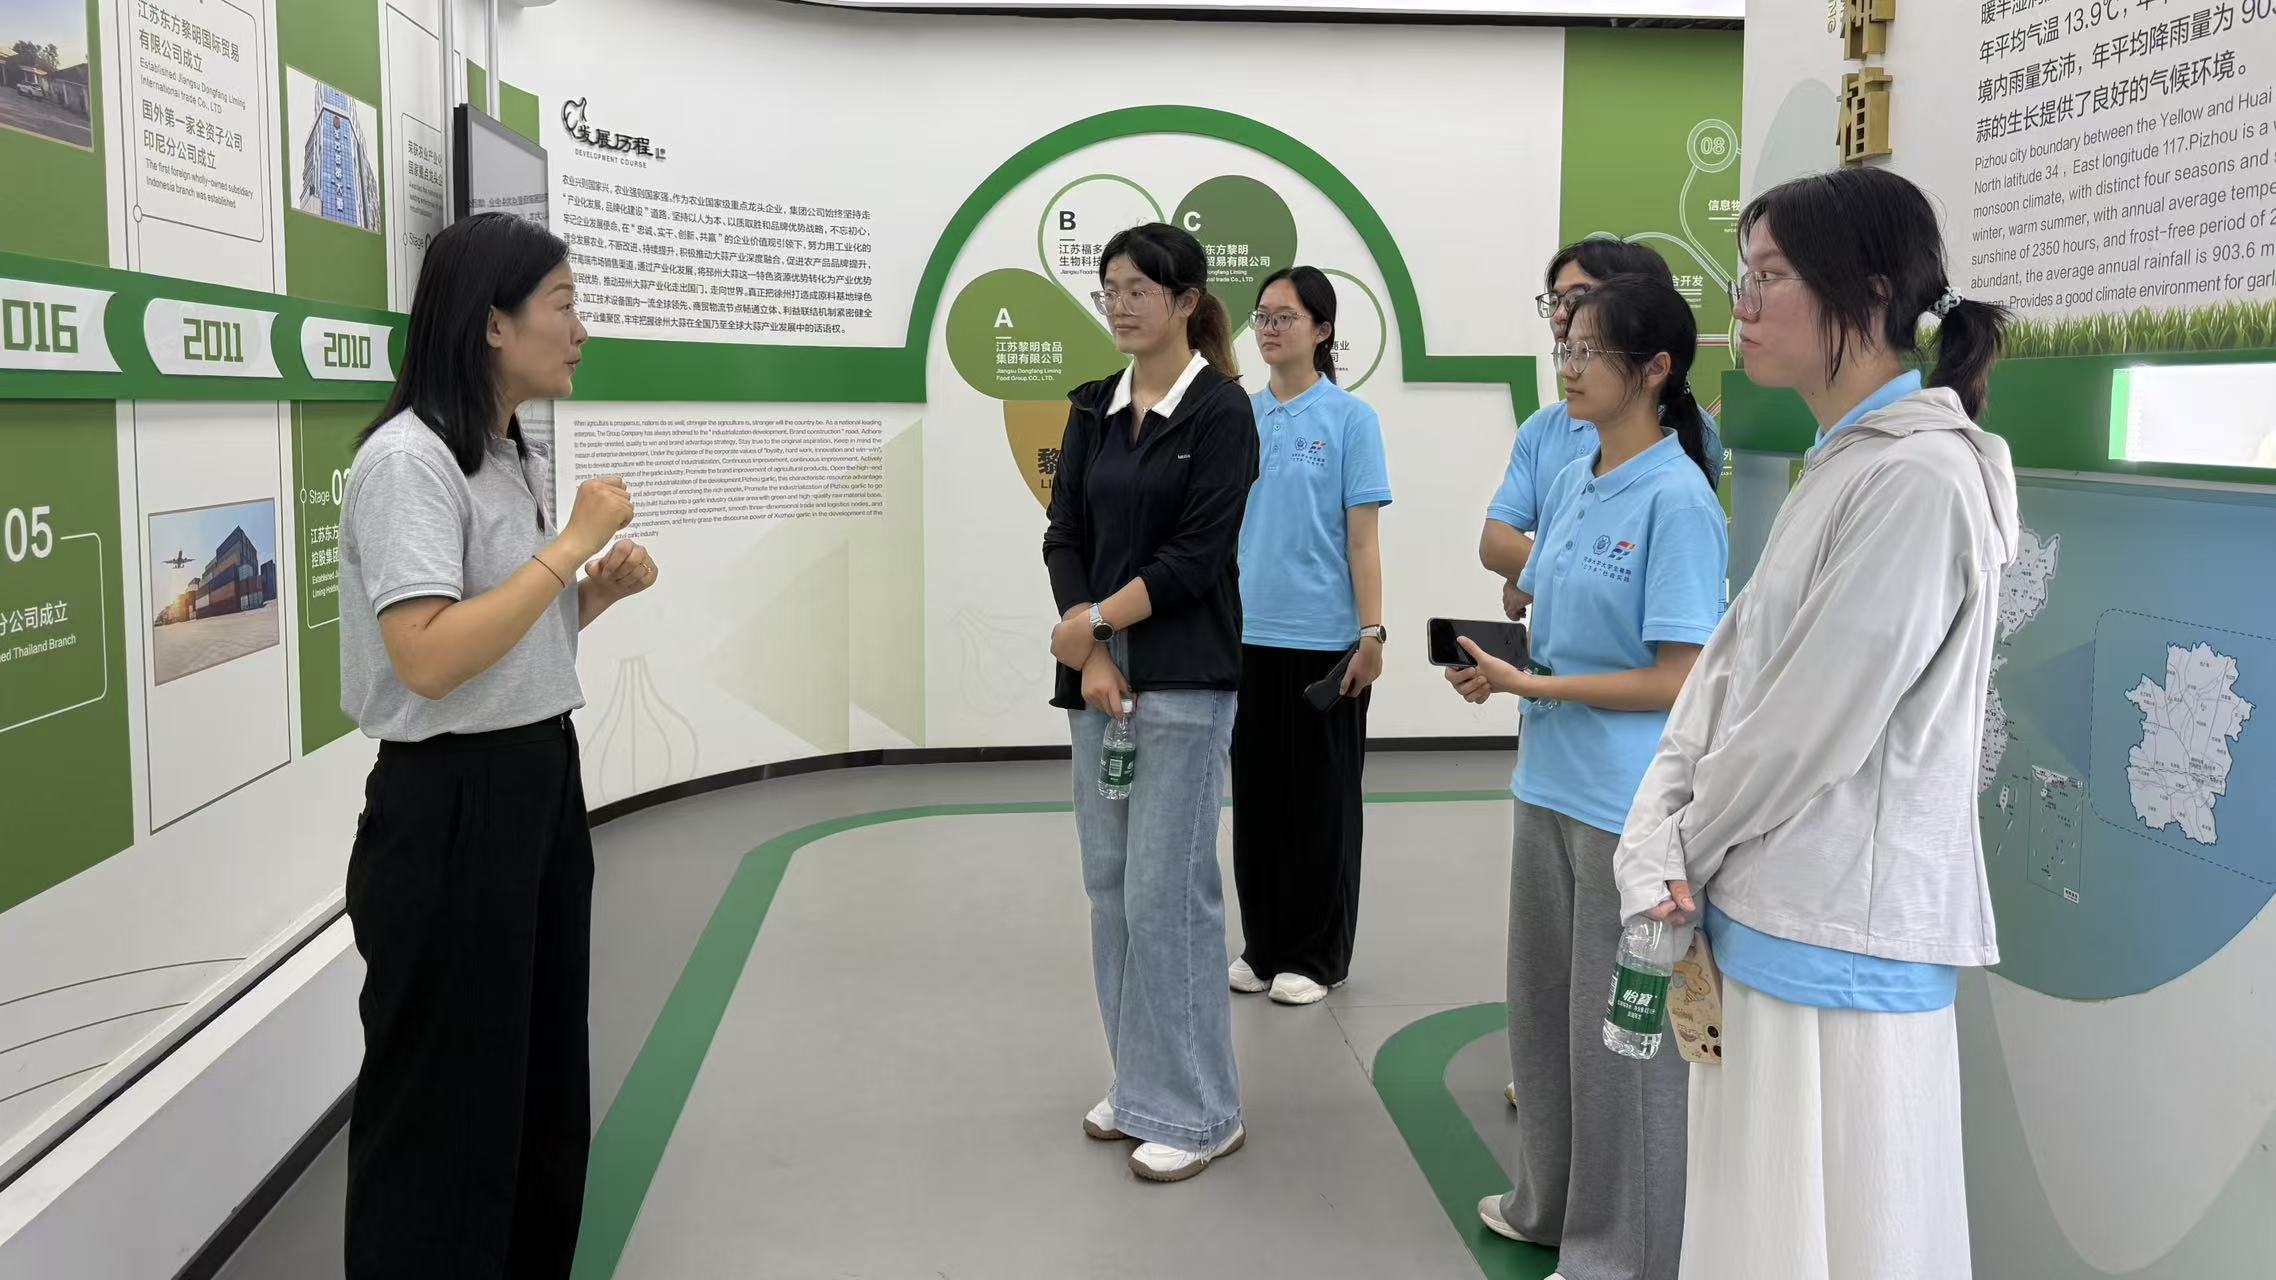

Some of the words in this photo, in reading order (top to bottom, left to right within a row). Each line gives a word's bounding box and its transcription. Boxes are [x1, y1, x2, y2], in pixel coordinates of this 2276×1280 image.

[2241, 0, 2276, 24] 90
[138, 0, 239, 62] 江苏东方黎明国际贸易
[1979, 15, 2060, 64] 年平均气温
[139, 28, 203, 73] 有限公司成立
[140, 57, 176, 80] Established
[178, 74, 201, 91] Jiangsu
[202, 82, 228, 103] Dongfang
[229, 93, 246, 110] Liming
[141, 74, 180, 98] International
[181, 89, 196, 105] trade
[210, 101, 222, 114] LTD
[1976, 50, 2246, 143] 蒜的生长提供了良好的气候环境。
[142, 98, 243, 152] 国外第一家全资子公司
[577, 124, 654, 157] 发展历程
[1975, 153, 2007, 170] Pizhou
[2009, 147, 2027, 163] city
[2029, 135, 2081, 158] boundary
[2083, 123, 2133, 146] between
[2137, 117, 2157, 133] the
[2160, 106, 2204, 127] Yellow
[2207, 95, 2234, 117] and
[2238, 86, 2272, 111] Huai
[143, 129, 217, 170] 印尼分公司成立
[575, 148, 618, 164] DEVELOPMENT
[620, 158, 648, 169] COURSE
[1700, 136, 1726, 155] 08
[1974, 177, 2001, 195] North
[2004, 168, 2042, 188] latitude
[2073, 155, 2099, 174] East
[2102, 144, 2159, 168] longitude
[2162, 129, 2238, 156] 117.Pizhou
[2242, 123, 2254, 139] is
[2258, 122, 2268, 136] a
[145, 158, 158, 171] The
[158, 161, 170, 174] first
[171, 165, 191, 181] foreign
[146, 175, 175, 192] Indonesia
[176, 183, 195, 198] branch
[1973, 200, 2019, 219] monsoon
[2022, 190, 2065, 209] climate,
[2068, 183, 2092, 201] with
[2095, 174, 2140, 195] distinct
[2143, 170, 2171, 187] four
[2174, 159, 2235, 182] seasons
[2239, 148, 2269, 170] and
[1059, 211, 1076, 230] B
[1183, 211, 1201, 232] C
[1972, 226, 2005, 242] winter,
[2008, 221, 2037, 236] warm
[2040, 212, 2090, 231] summer,
[2093, 206, 2118, 221] with
[2121, 196, 2165, 218] annual
[2168, 190, 2226, 211] average
[1971, 248, 2016, 266] sunshine
[2019, 244, 2030, 259] of
[2032, 240, 2060, 257] 2350
[2063, 238, 2099, 253] hours,
[2103, 230, 2126, 248] and
[2130, 222, 2195, 244] frost-free
[2199, 212, 2246, 238] period
[2250, 209, 2266, 228] of
[1059, 256, 1101, 266] 生物科技
[1206, 256, 1270, 267] 贸易有限公司
[1971, 271, 2022, 289] abundant,
[2026, 268, 2043, 283] the
[2046, 264, 2094, 281] average
[2097, 255, 2140, 278] annual
[2144, 248, 2191, 270] rainfall
[2195, 248, 2207, 264] is
[2212, 241, 2255, 262] 903.6
[2009, 292, 2053, 309] Provides
[2055, 296, 2063, 305] a
[2065, 288, 2093, 308] good
[2095, 284, 2136, 301] climate
[2139, 275, 2221, 298] environment
[2224, 273, 2244, 290] for
[994, 308, 1014, 327] A
[183, 317, 243, 362] 2011
[323, 332, 371, 369] 2010
[996, 341, 1063, 352] 江苏黎明食品
[996, 353, 1063, 364] 集团有限公司
[309, 489, 330, 505] Stage
[4, 505, 53, 563] 05
[311, 525, 339, 544] 江苏东方
[311, 546, 339, 568] 控股集团
[13, 639, 47, 659] Thailand
[49, 633, 76, 650] Branch
